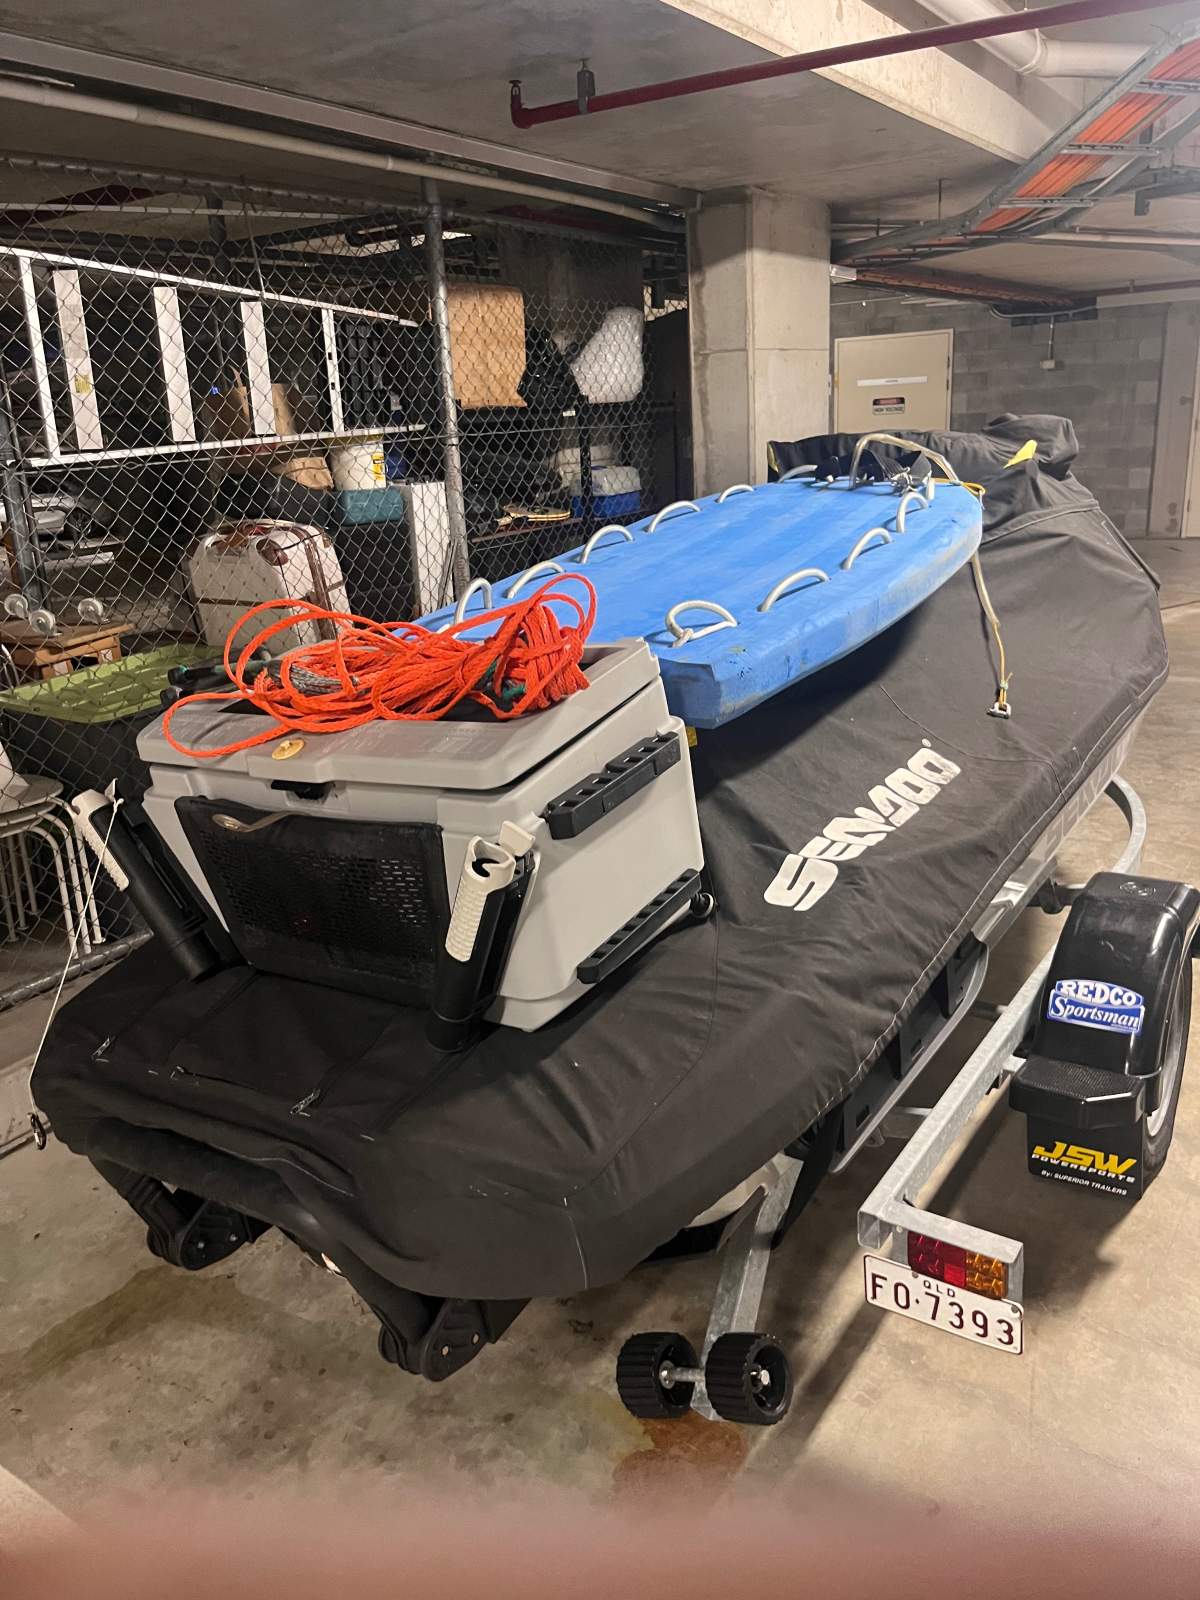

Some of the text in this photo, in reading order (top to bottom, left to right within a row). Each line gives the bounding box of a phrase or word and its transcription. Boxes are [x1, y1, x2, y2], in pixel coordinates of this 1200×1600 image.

[1060, 981, 1137, 1007] REDCO
[1050, 996, 1140, 1027] Sportsman
[1031, 1153, 1136, 1183] POWERSPORTS
[1033, 1141, 1137, 1174] JSW
[1041, 1169, 1128, 1196] By: SUPERIOR TRAILERS
[923, 1279, 956, 1298] QLD
